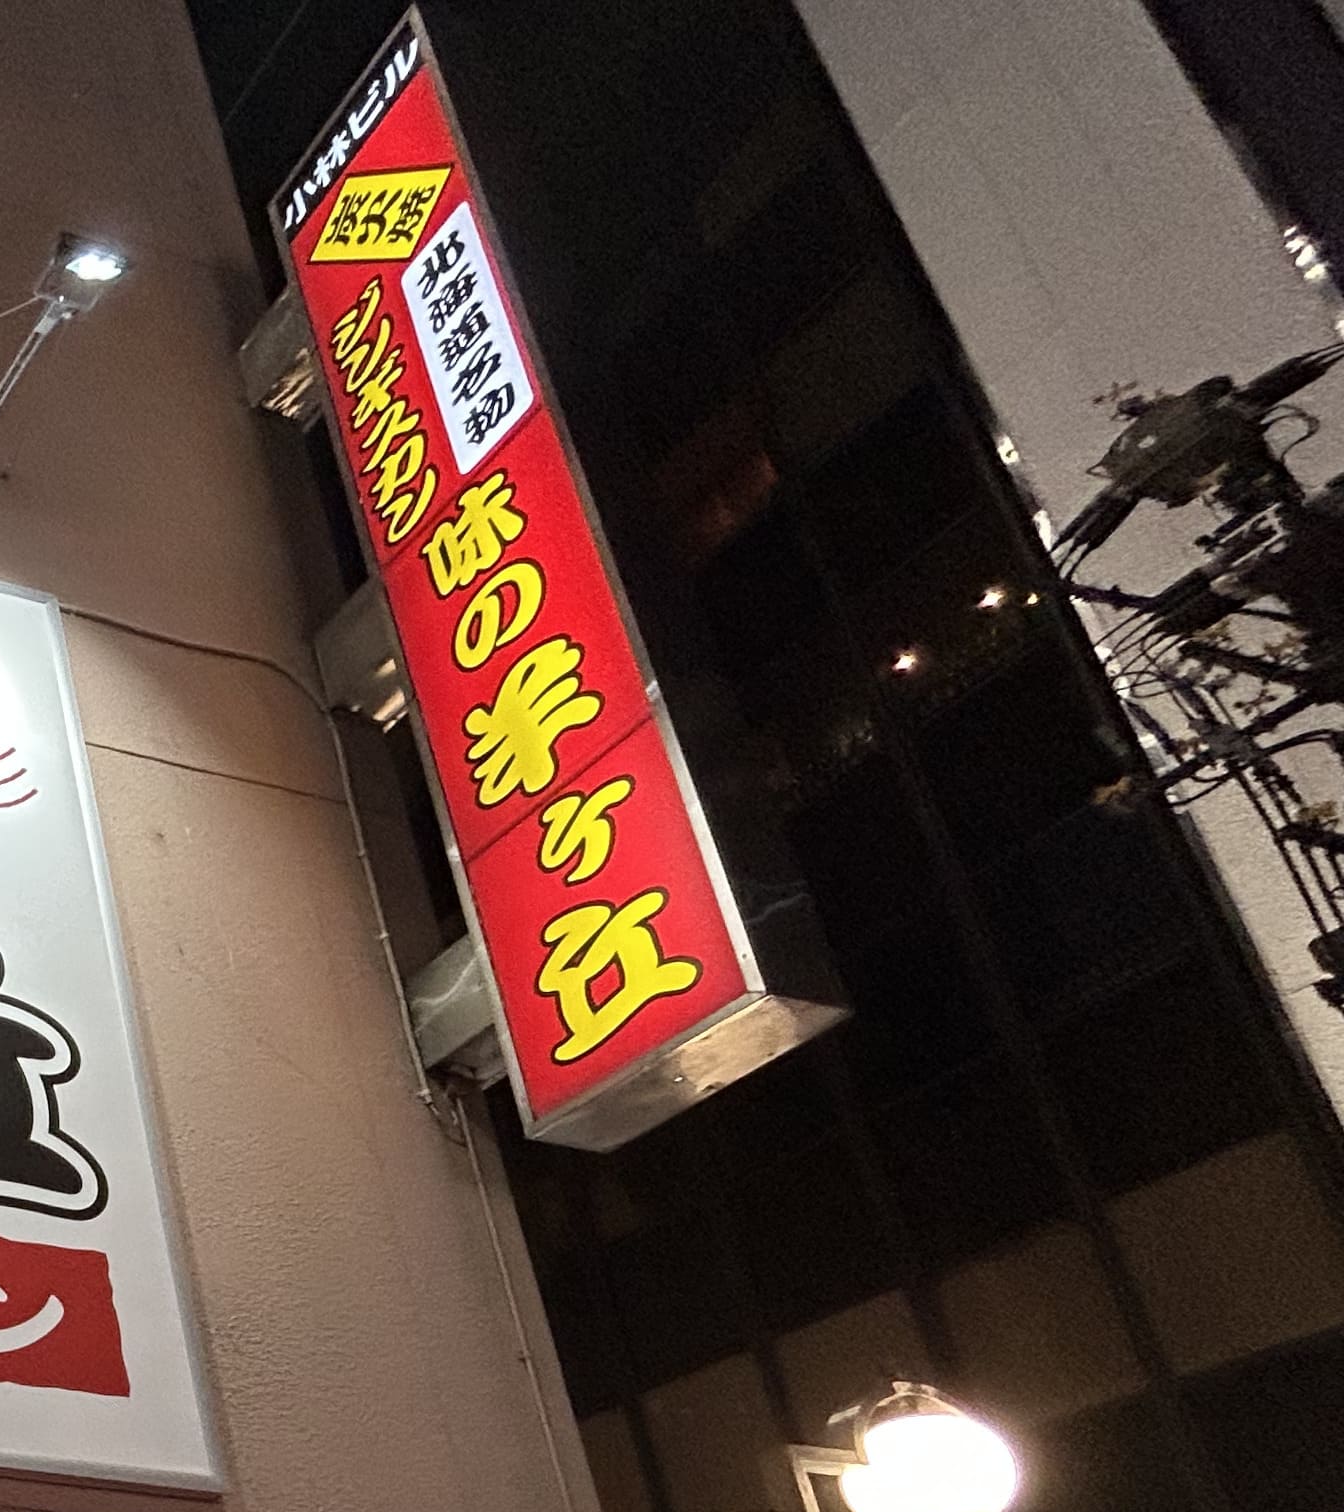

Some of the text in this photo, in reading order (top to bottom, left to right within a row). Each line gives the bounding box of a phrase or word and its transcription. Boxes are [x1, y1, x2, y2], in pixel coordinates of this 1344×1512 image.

[283, 38, 419, 230] 小林ビル
[324, 185, 436, 246] 炭火焼
[331, 277, 438, 545] ジンギスカン
[418, 228, 516, 444] 北海道名物
[421, 472, 701, 1065] 味の羊ヶ丘
